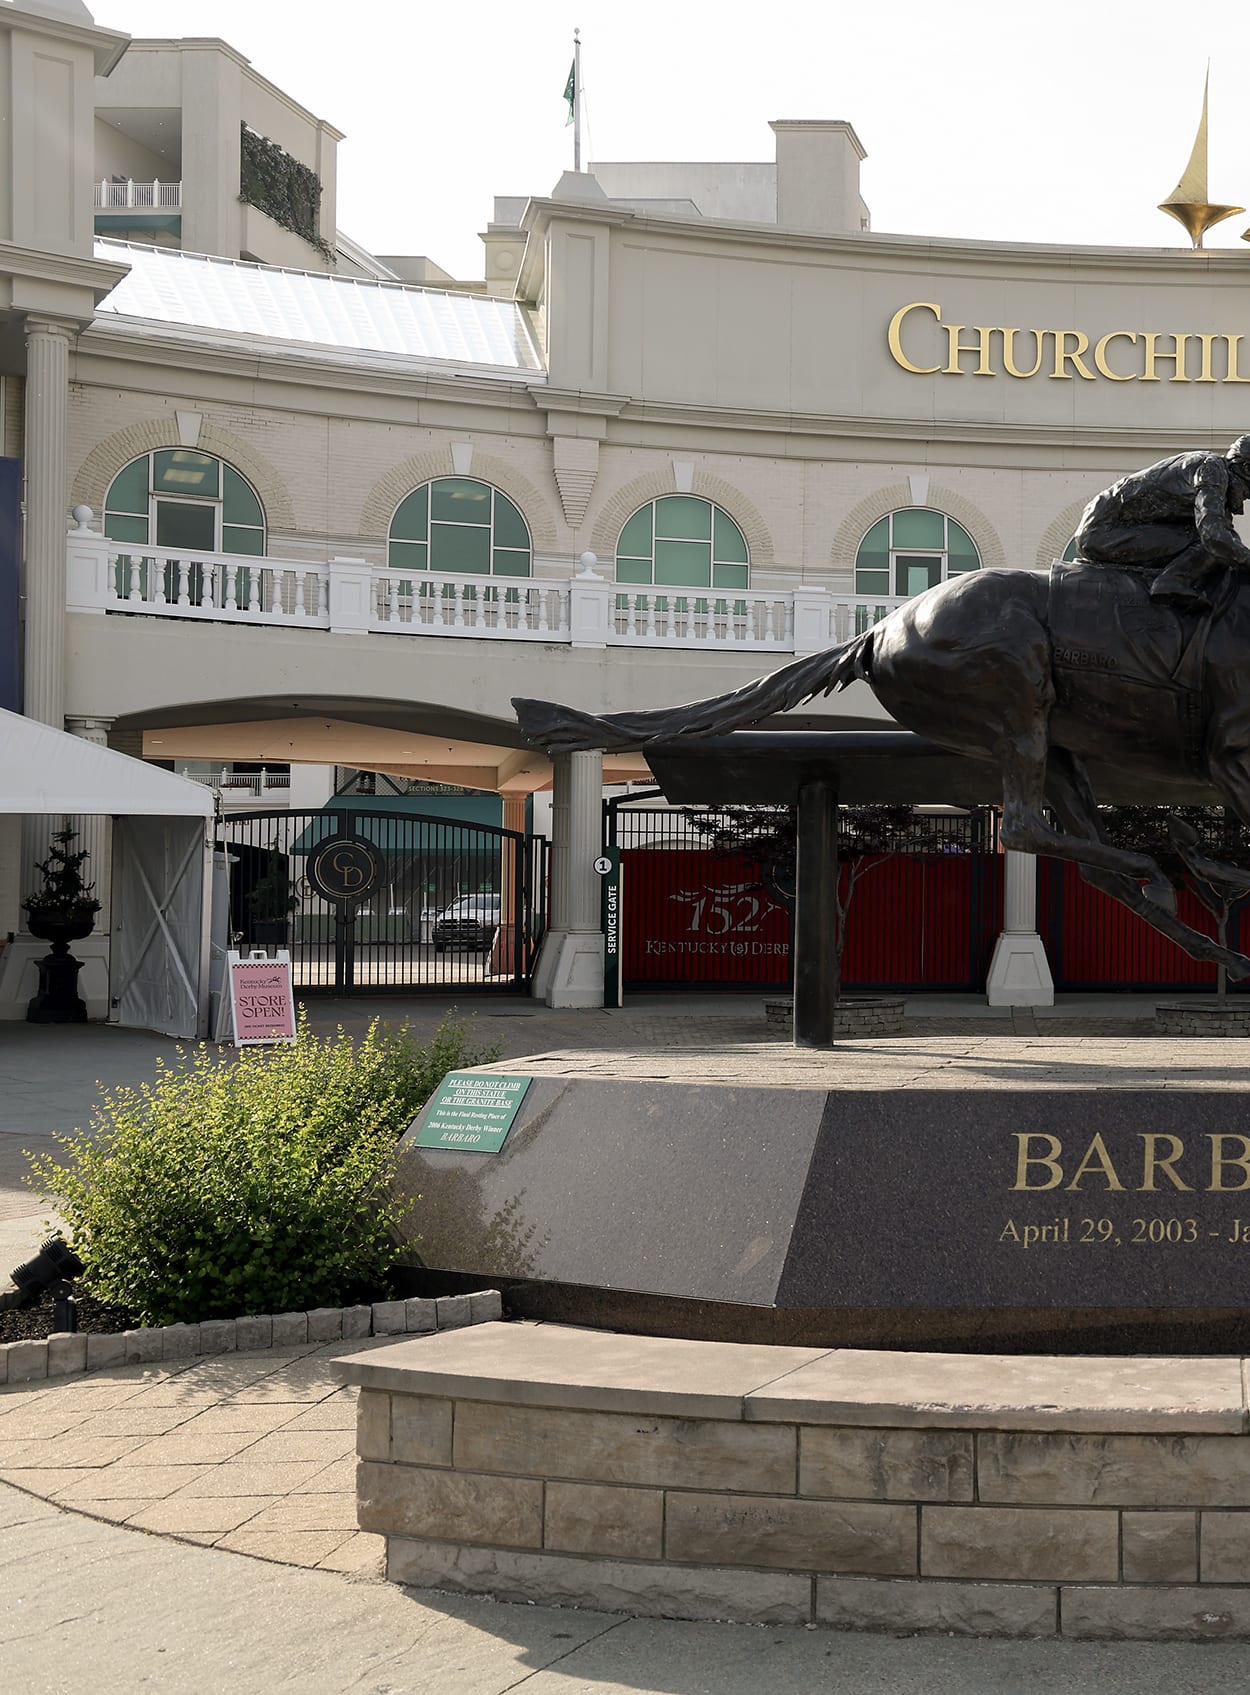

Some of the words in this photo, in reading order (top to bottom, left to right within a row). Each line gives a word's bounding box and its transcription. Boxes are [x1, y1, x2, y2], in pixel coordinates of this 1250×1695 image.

[408, 785, 439, 793] SECTIONS
[599, 860, 608, 872] 1
[607, 885, 617, 911] GATE
[607, 912, 617, 954] SERVICE
[645, 940, 729, 955] KENTUCKY
[752, 940, 790, 955] DERB
[239, 995, 287, 1007] STORE
[242, 1007, 285, 1018] OPEN!
[449, 1079, 474, 1087] PLEASE
[474, 1080, 485, 1088] DO
[485, 1081, 498, 1089] NOT
[498, 1082, 521, 1090] CLIMB
[466, 1089, 482, 1097] THIS
[482, 1090, 507, 1098] STATUE
[441, 1096, 452, 1104] OR
[452, 1097, 465, 1105] THE
[465, 1098, 496, 1106] GRANITE
[428, 1121, 441, 1129] 2006
[441, 1123, 465, 1132] Kentucky
[466, 1124, 482, 1133] Derby
[483, 1125, 503, 1133] Winner
[440, 1132, 481, 1143] BARBARO
[998, 1217, 1070, 1249] April
[1079, 1218, 1123, 1247] 29,
[1132, 1218, 1199, 1244] 2003
